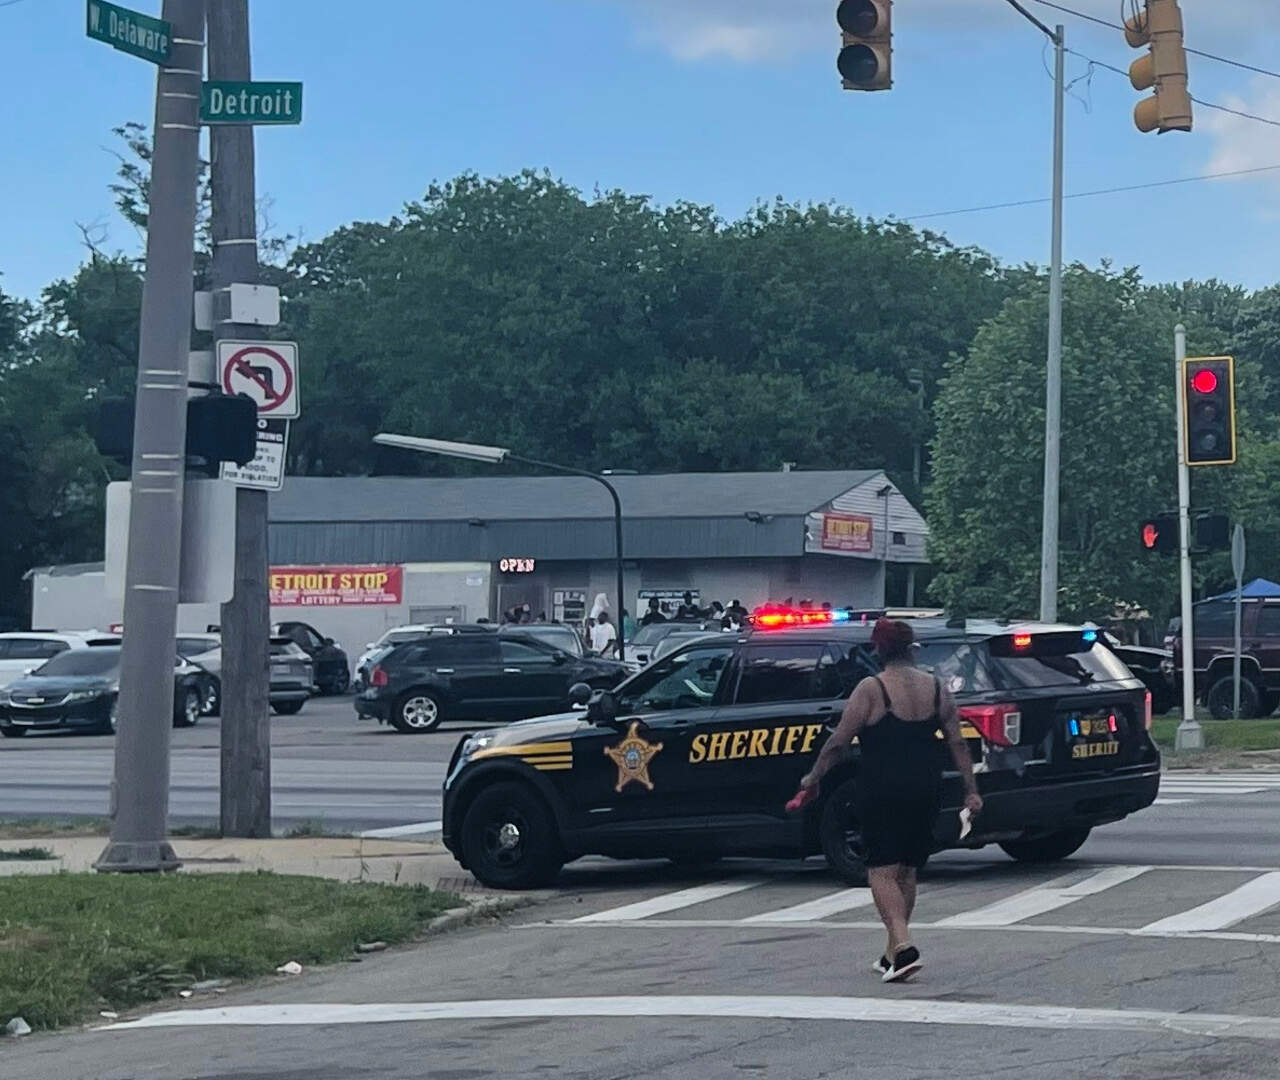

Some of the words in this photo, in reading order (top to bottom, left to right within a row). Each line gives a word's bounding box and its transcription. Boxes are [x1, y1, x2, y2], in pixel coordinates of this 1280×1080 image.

[109, 11, 168, 54] Delaware
[210, 88, 293, 115] Detroit
[500, 558, 535, 572] OPEN
[270, 574, 336, 590] ETROIT
[340, 572, 388, 589] STOP
[301, 596, 341, 605] LOTTERY
[689, 724, 823, 763] SHERIFF
[1072, 741, 1119, 758] SHERIFF
